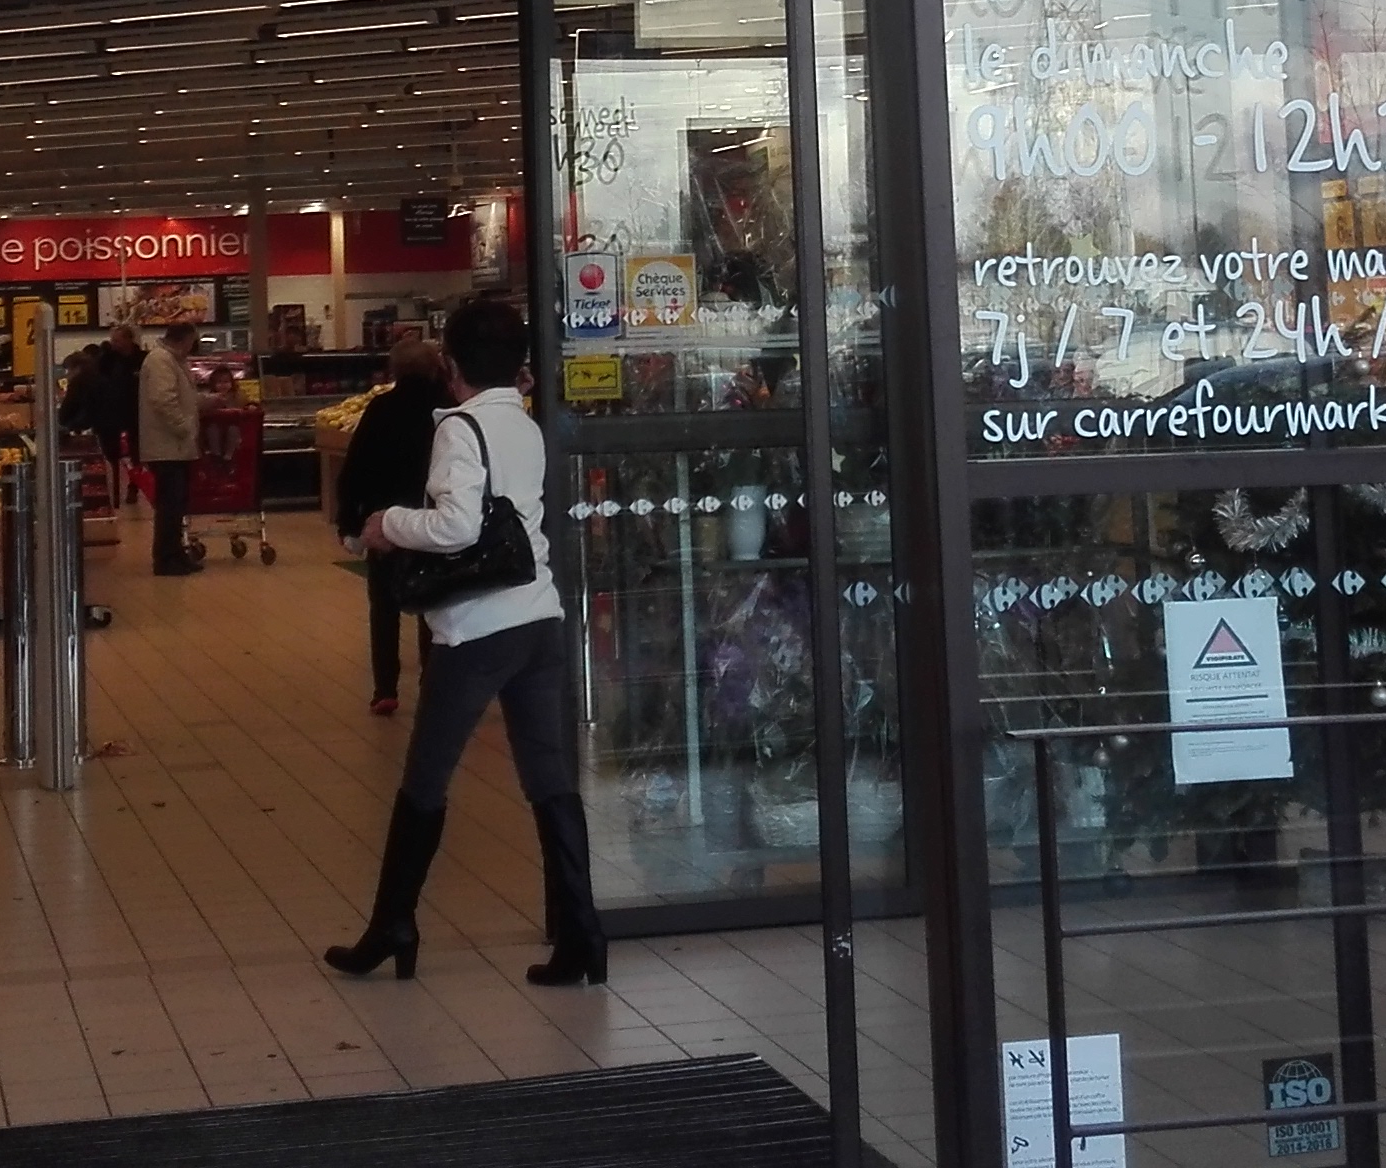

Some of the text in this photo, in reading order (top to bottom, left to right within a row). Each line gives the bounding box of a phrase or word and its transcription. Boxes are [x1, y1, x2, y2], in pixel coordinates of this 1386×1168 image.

[963, 17, 1289, 81] le dimanche
[966, 96, 1157, 181] 9h00
[973, 241, 1188, 288] retrouvez
[1199, 237, 1309, 284] votre
[637, 273, 684, 287] Chèque
[635, 286, 687, 298] Services
[573, 299, 612, 310] Ticket
[974, 307, 1031, 389] 7j
[1101, 306, 1135, 363] 7
[1160, 303, 1216, 362] et
[1235, 294, 1353, 364] 24h
[982, 405, 1058, 443] sur
[1205, 654, 1246, 662] VIGIPIRATE
[1190, 670, 1261, 682] RISQUE ATTENTAT
[1268, 1077, 1332, 1109] ISO
[1275, 1124, 1293, 1138] ISO
[1296, 1120, 1331, 1136] 50001
[1277, 1138, 1332, 1154] 2014-2016
